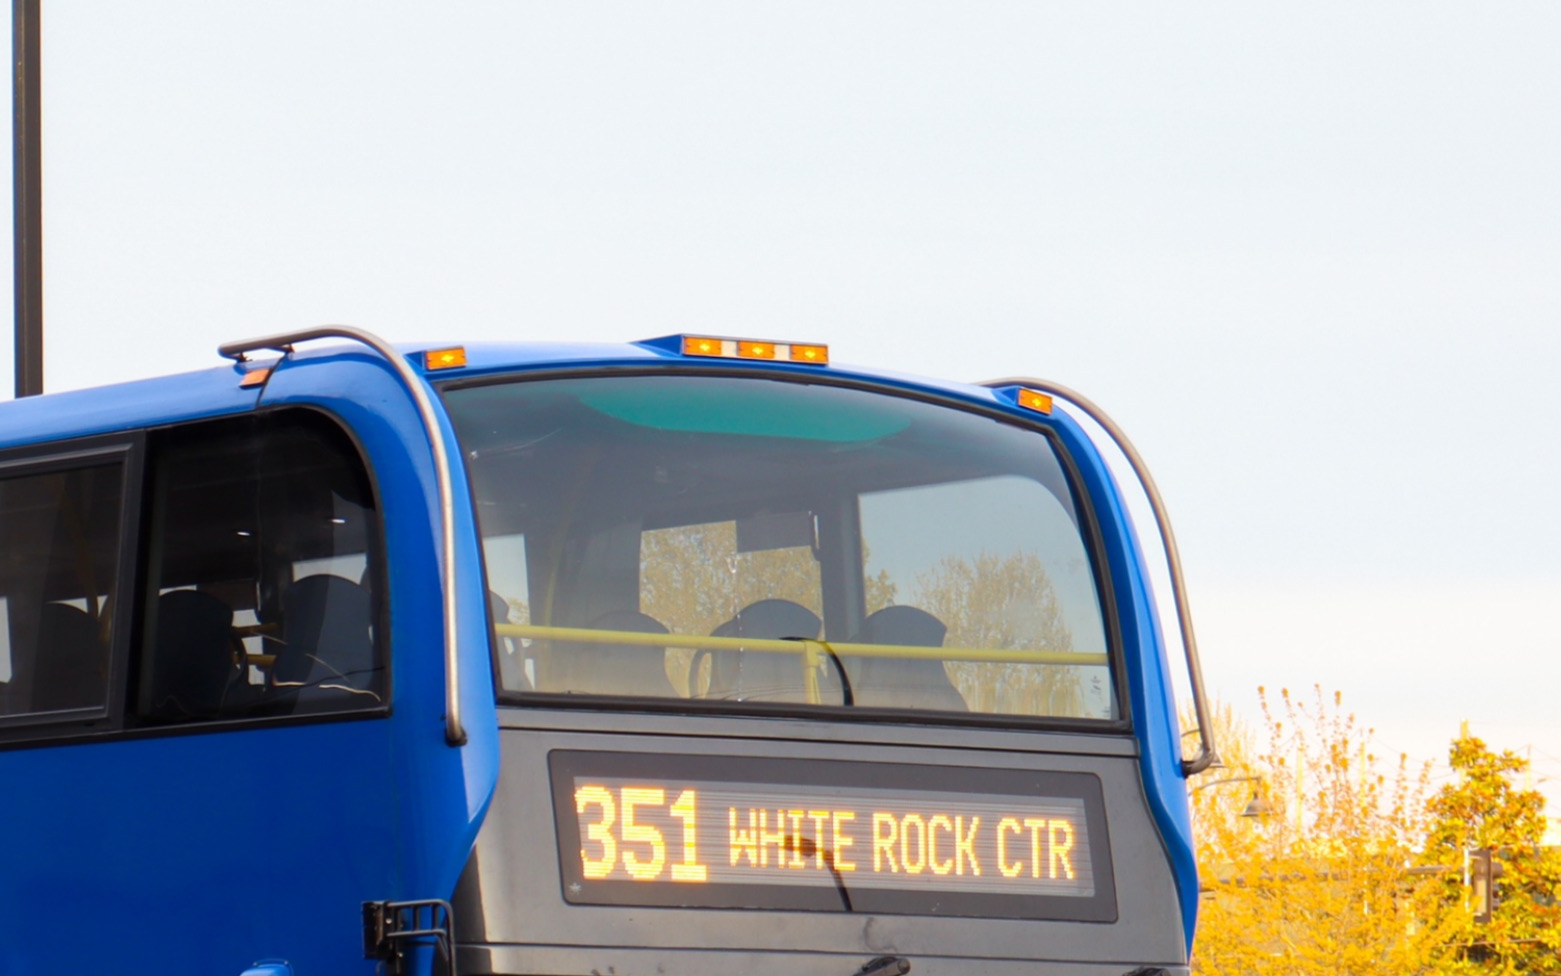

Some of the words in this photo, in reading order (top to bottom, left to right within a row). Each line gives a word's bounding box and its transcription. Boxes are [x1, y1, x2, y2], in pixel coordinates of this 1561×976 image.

[574, 785, 707, 883] 351
[729, 806, 856, 872] WHITE
[872, 812, 981, 877] ROCK
[997, 817, 1076, 880] CTR
